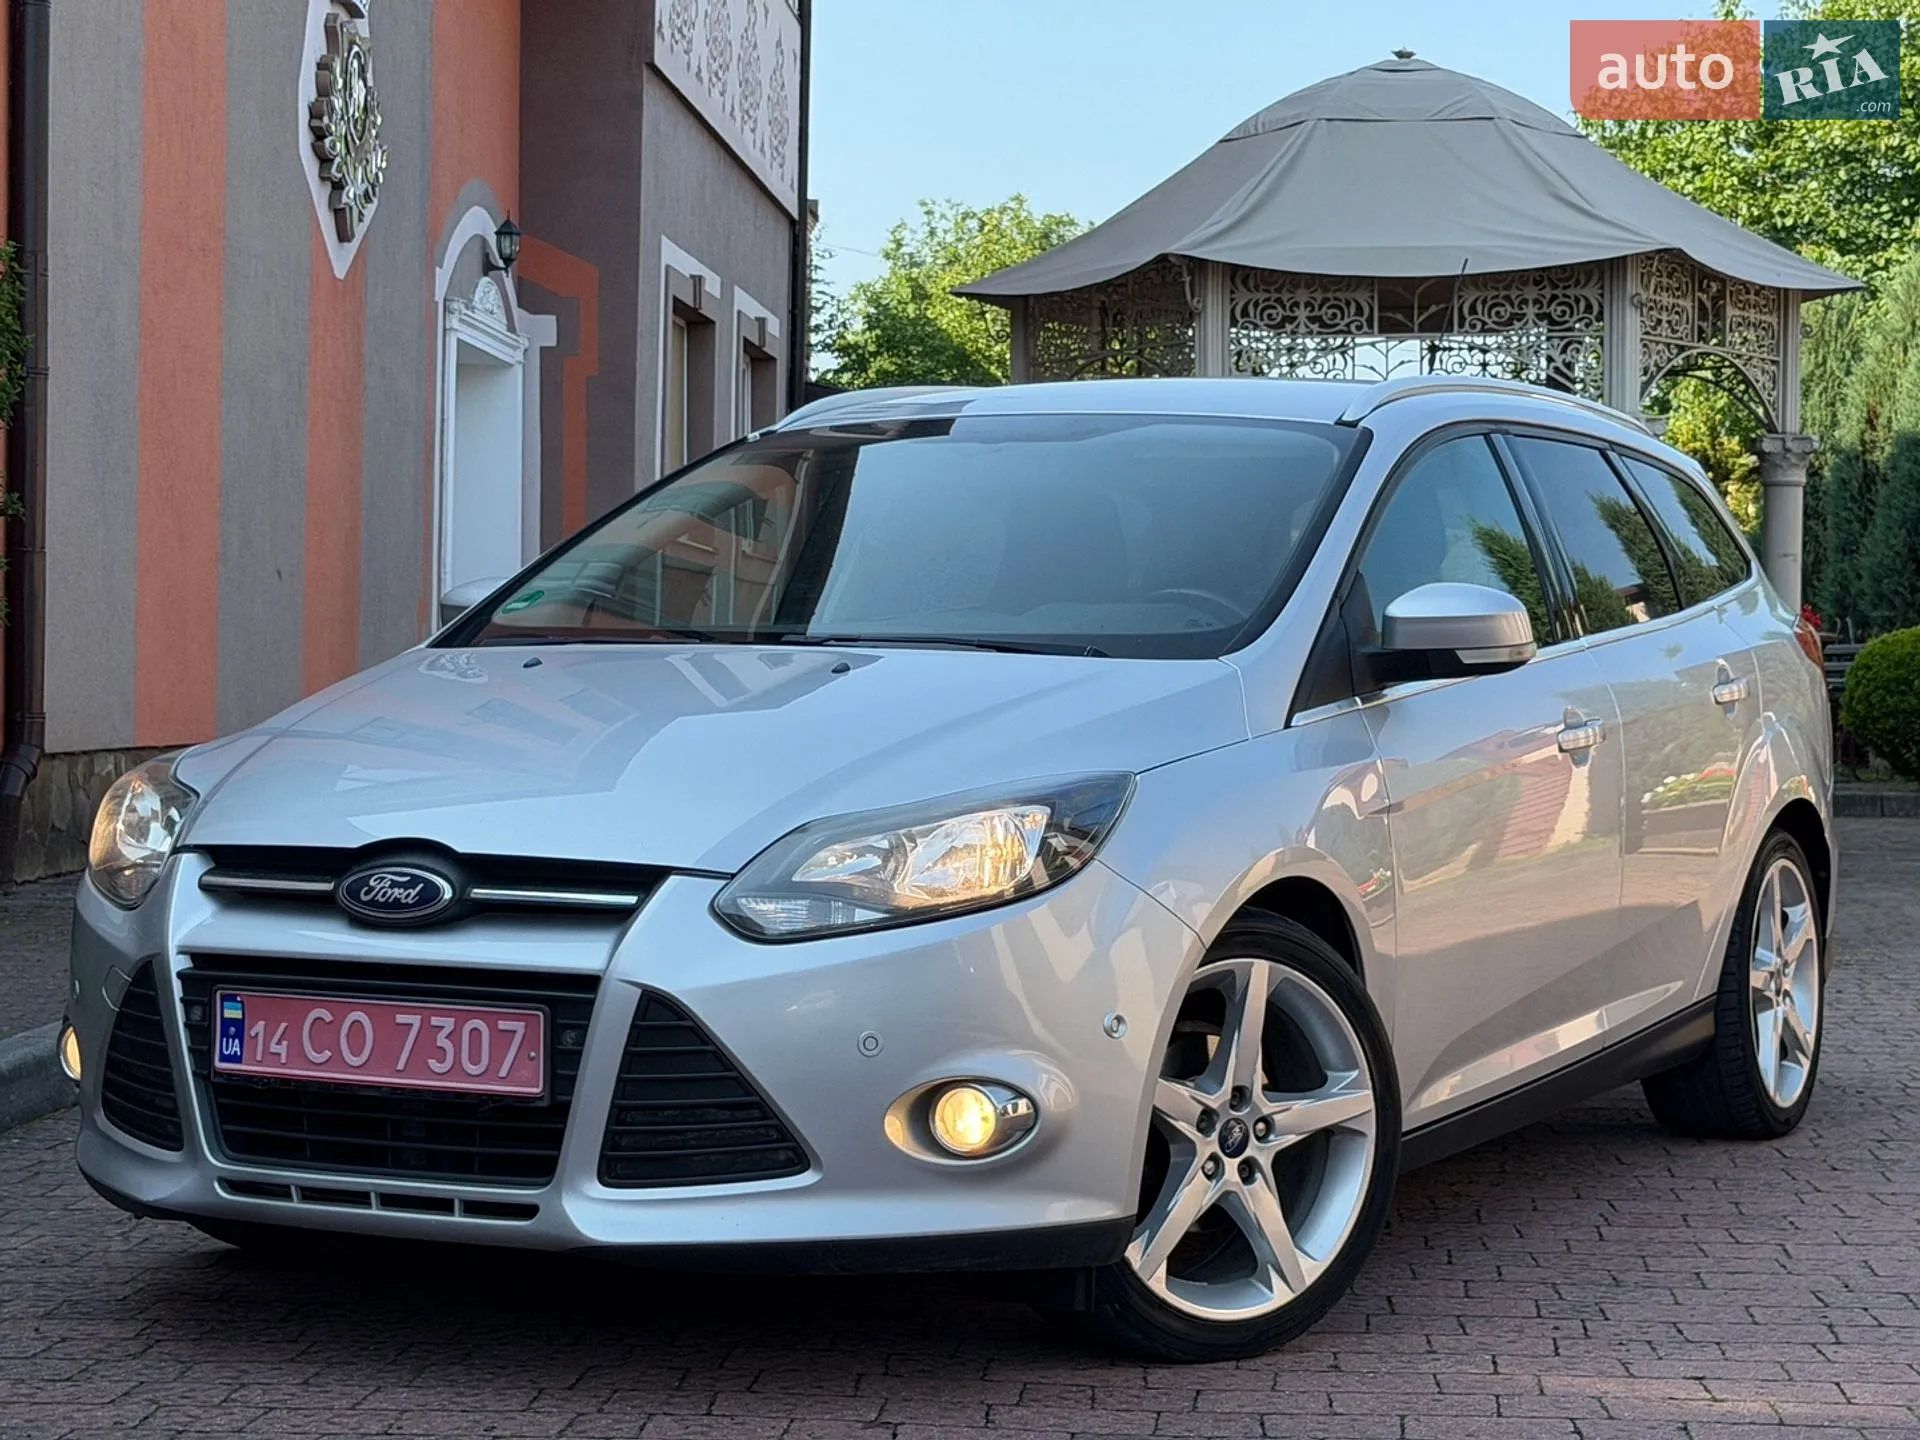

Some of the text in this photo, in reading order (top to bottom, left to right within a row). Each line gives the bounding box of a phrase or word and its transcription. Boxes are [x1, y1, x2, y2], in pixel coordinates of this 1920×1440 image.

[361, 873, 424, 904] Ford
[222, 1037, 241, 1056] UA
[250, 1008, 526, 1078] 14 CO 7307
